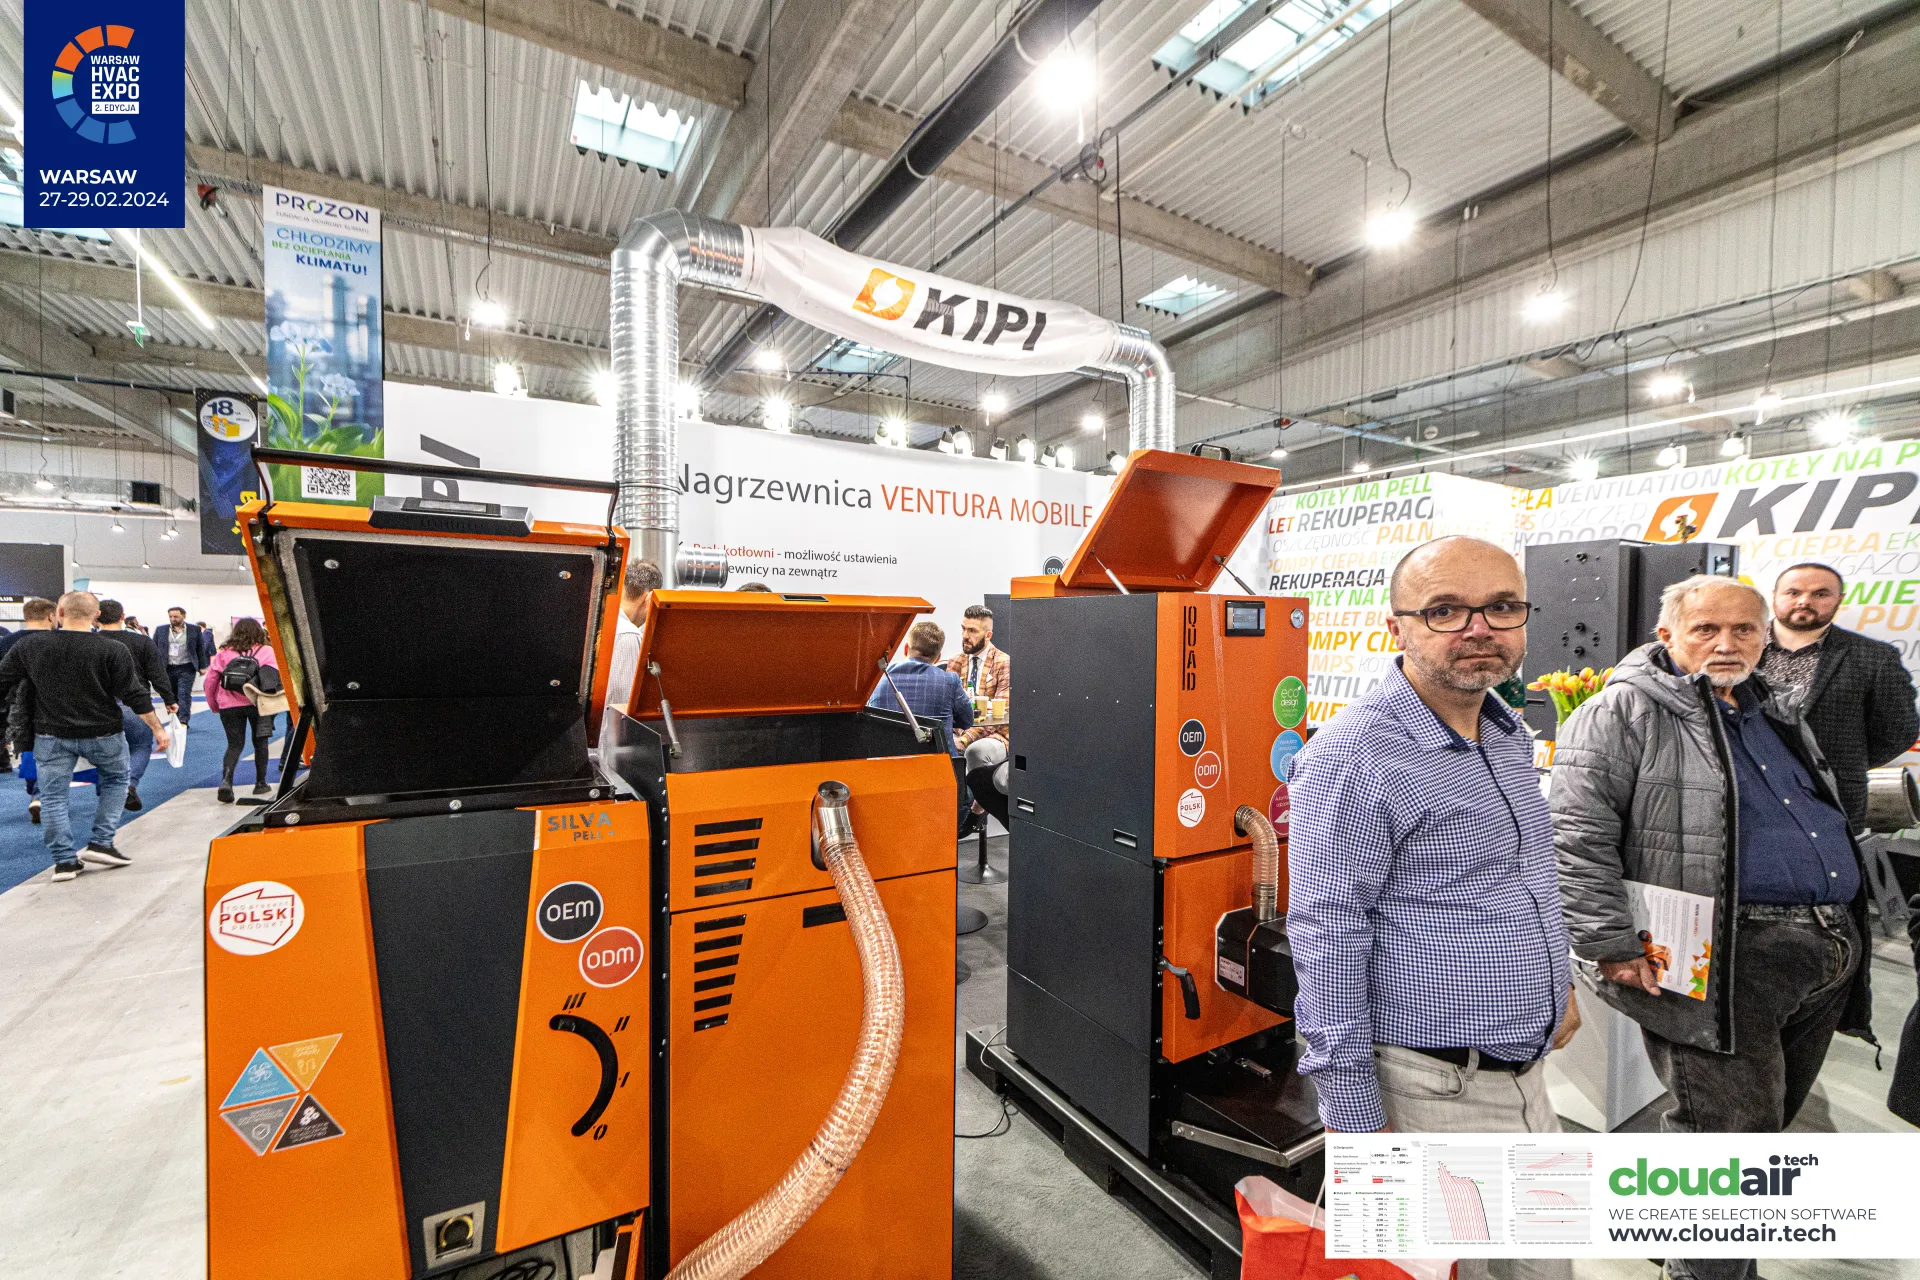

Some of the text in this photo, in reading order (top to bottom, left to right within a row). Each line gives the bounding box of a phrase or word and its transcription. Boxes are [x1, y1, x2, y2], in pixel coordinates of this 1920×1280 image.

[275, 191, 369, 224] PROZON
[271, 240, 290, 249] BEZ
[296, 253, 368, 276] KLIMATU!
[912, 287, 1047, 352] KIPI
[207, 400, 234, 416] 18
[1557, 467, 1723, 505] VENTILATION
[1724, 453, 1825, 486] KOTŁY
[1832, 446, 1883, 474] NA
[881, 484, 1003, 521] VENTURA
[1010, 497, 1093, 528] MOBILE
[1296, 487, 1349, 511] KOTŁY
[1353, 481, 1380, 503] NA
[1716, 471, 1920, 539] KIP
[723, 544, 775, 559] kotłowni
[784, 549, 842, 563] możliwość
[843, 552, 898, 565] ustawienia
[1772, 531, 1882, 558] CIEPŁA
[728, 563, 838, 580] ewnicy na zewnątrz
[1321, 551, 1378, 571] CIEPŁA
[1268, 568, 1386, 591] REKUPERACJA
[1348, 588, 1375, 606] NA
[1186, 605, 1198, 691] QUAD
[1281, 688, 1300, 699] eco
[1182, 731, 1203, 743] OEM
[1197, 764, 1218, 776] ODM
[547, 811, 613, 833] SILVA
[546, 899, 595, 922] OEM
[586, 946, 635, 970] ODM
